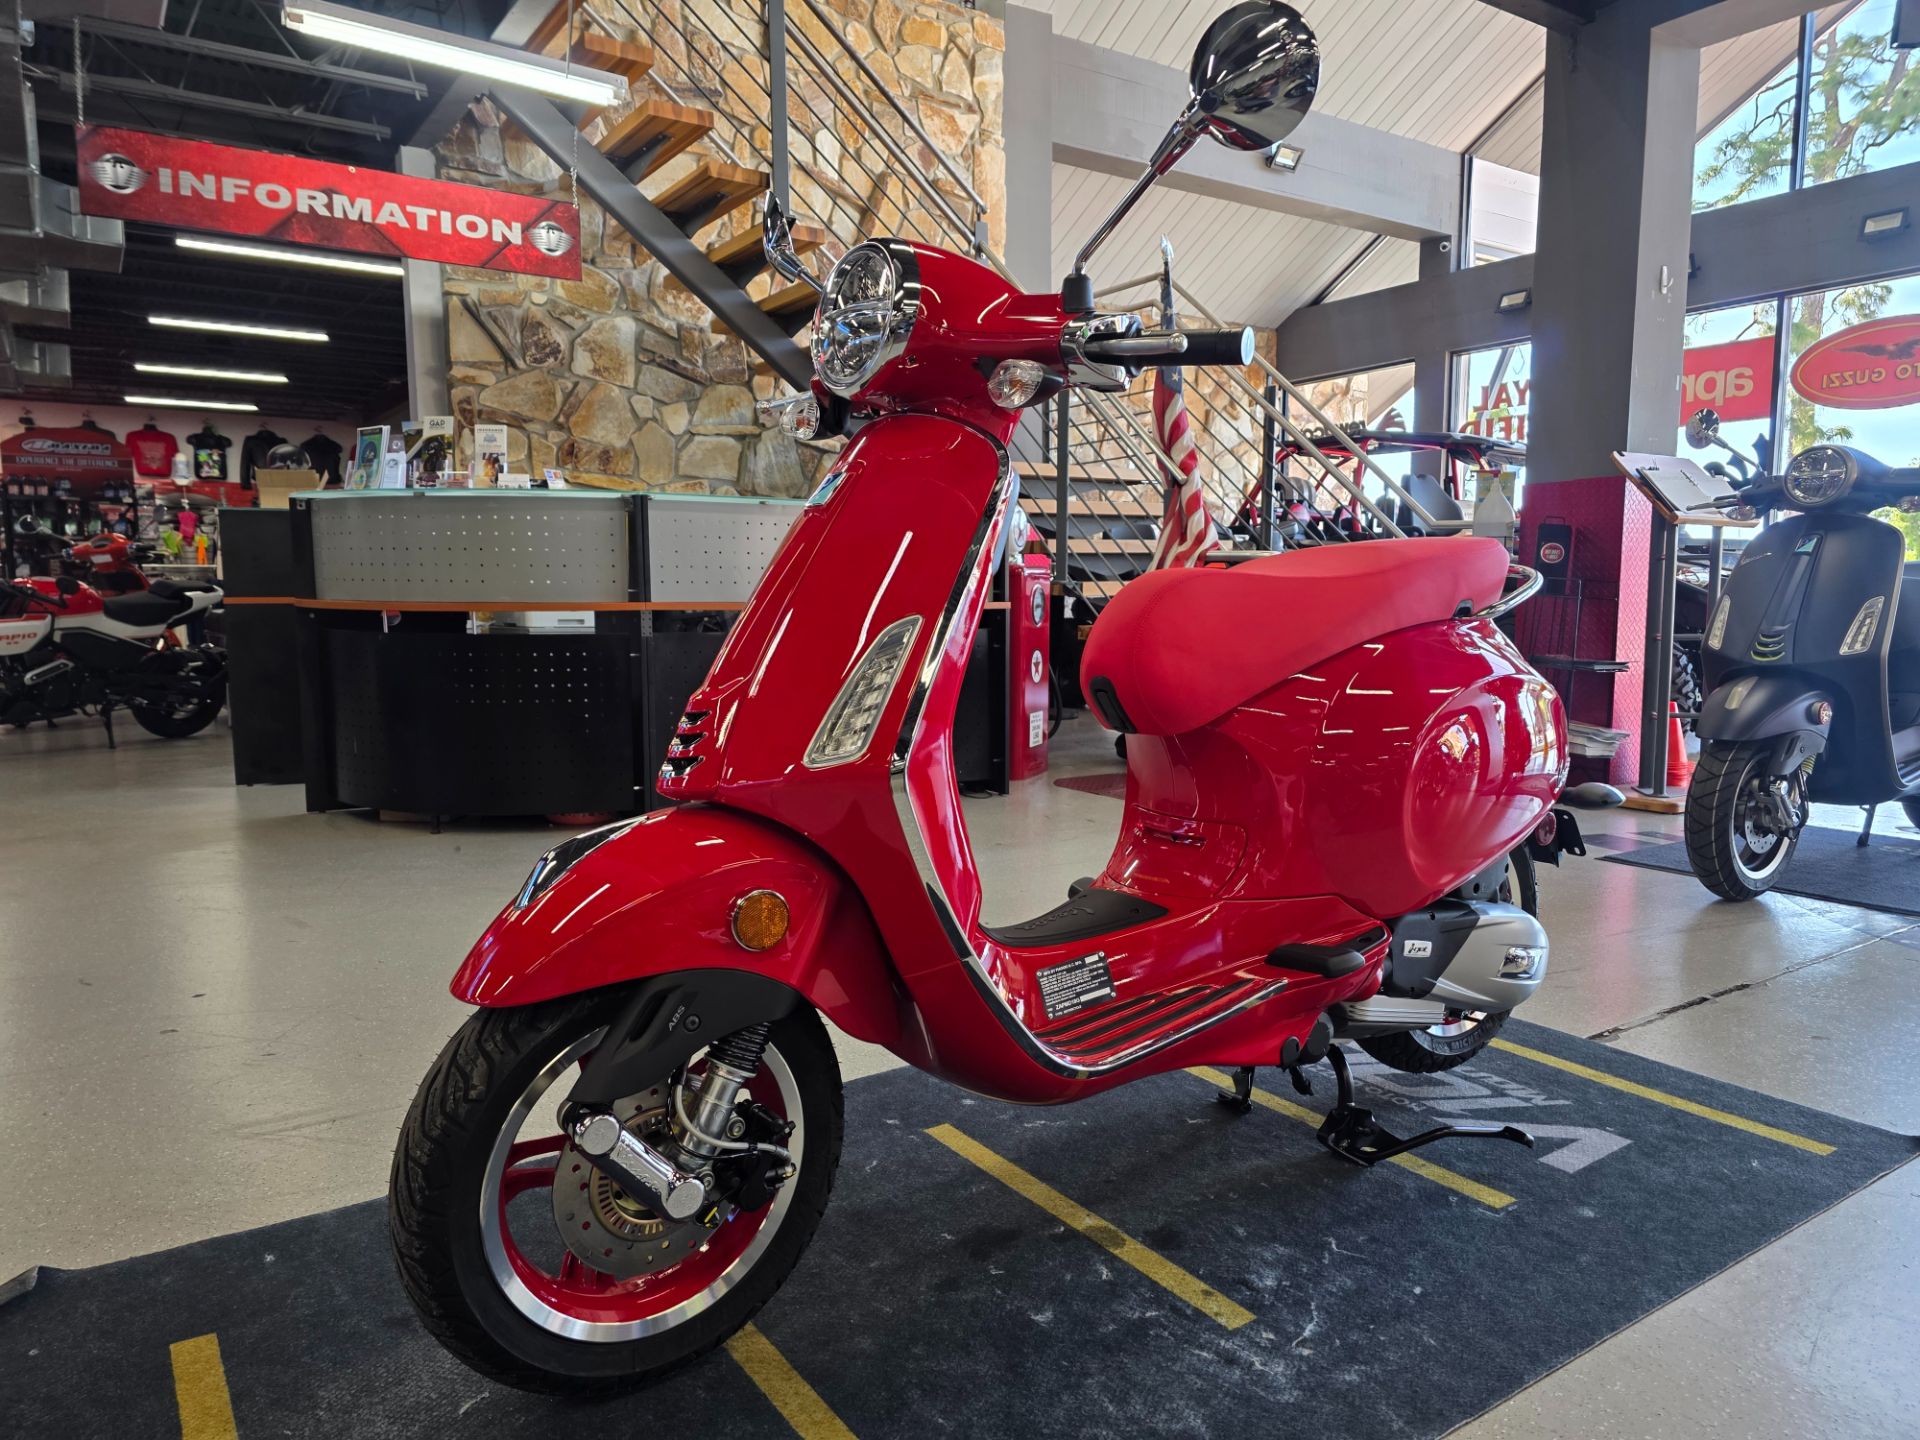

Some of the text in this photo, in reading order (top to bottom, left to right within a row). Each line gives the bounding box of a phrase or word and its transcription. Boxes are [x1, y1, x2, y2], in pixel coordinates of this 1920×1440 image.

[158, 167, 523, 246] INFORMATION
[429, 419, 446, 427] GAP
[16, 455, 59, 465] EXPERIENCE
[77, 458, 119, 468] DIFFERENCE
[668, 1003, 686, 1032] ABS
